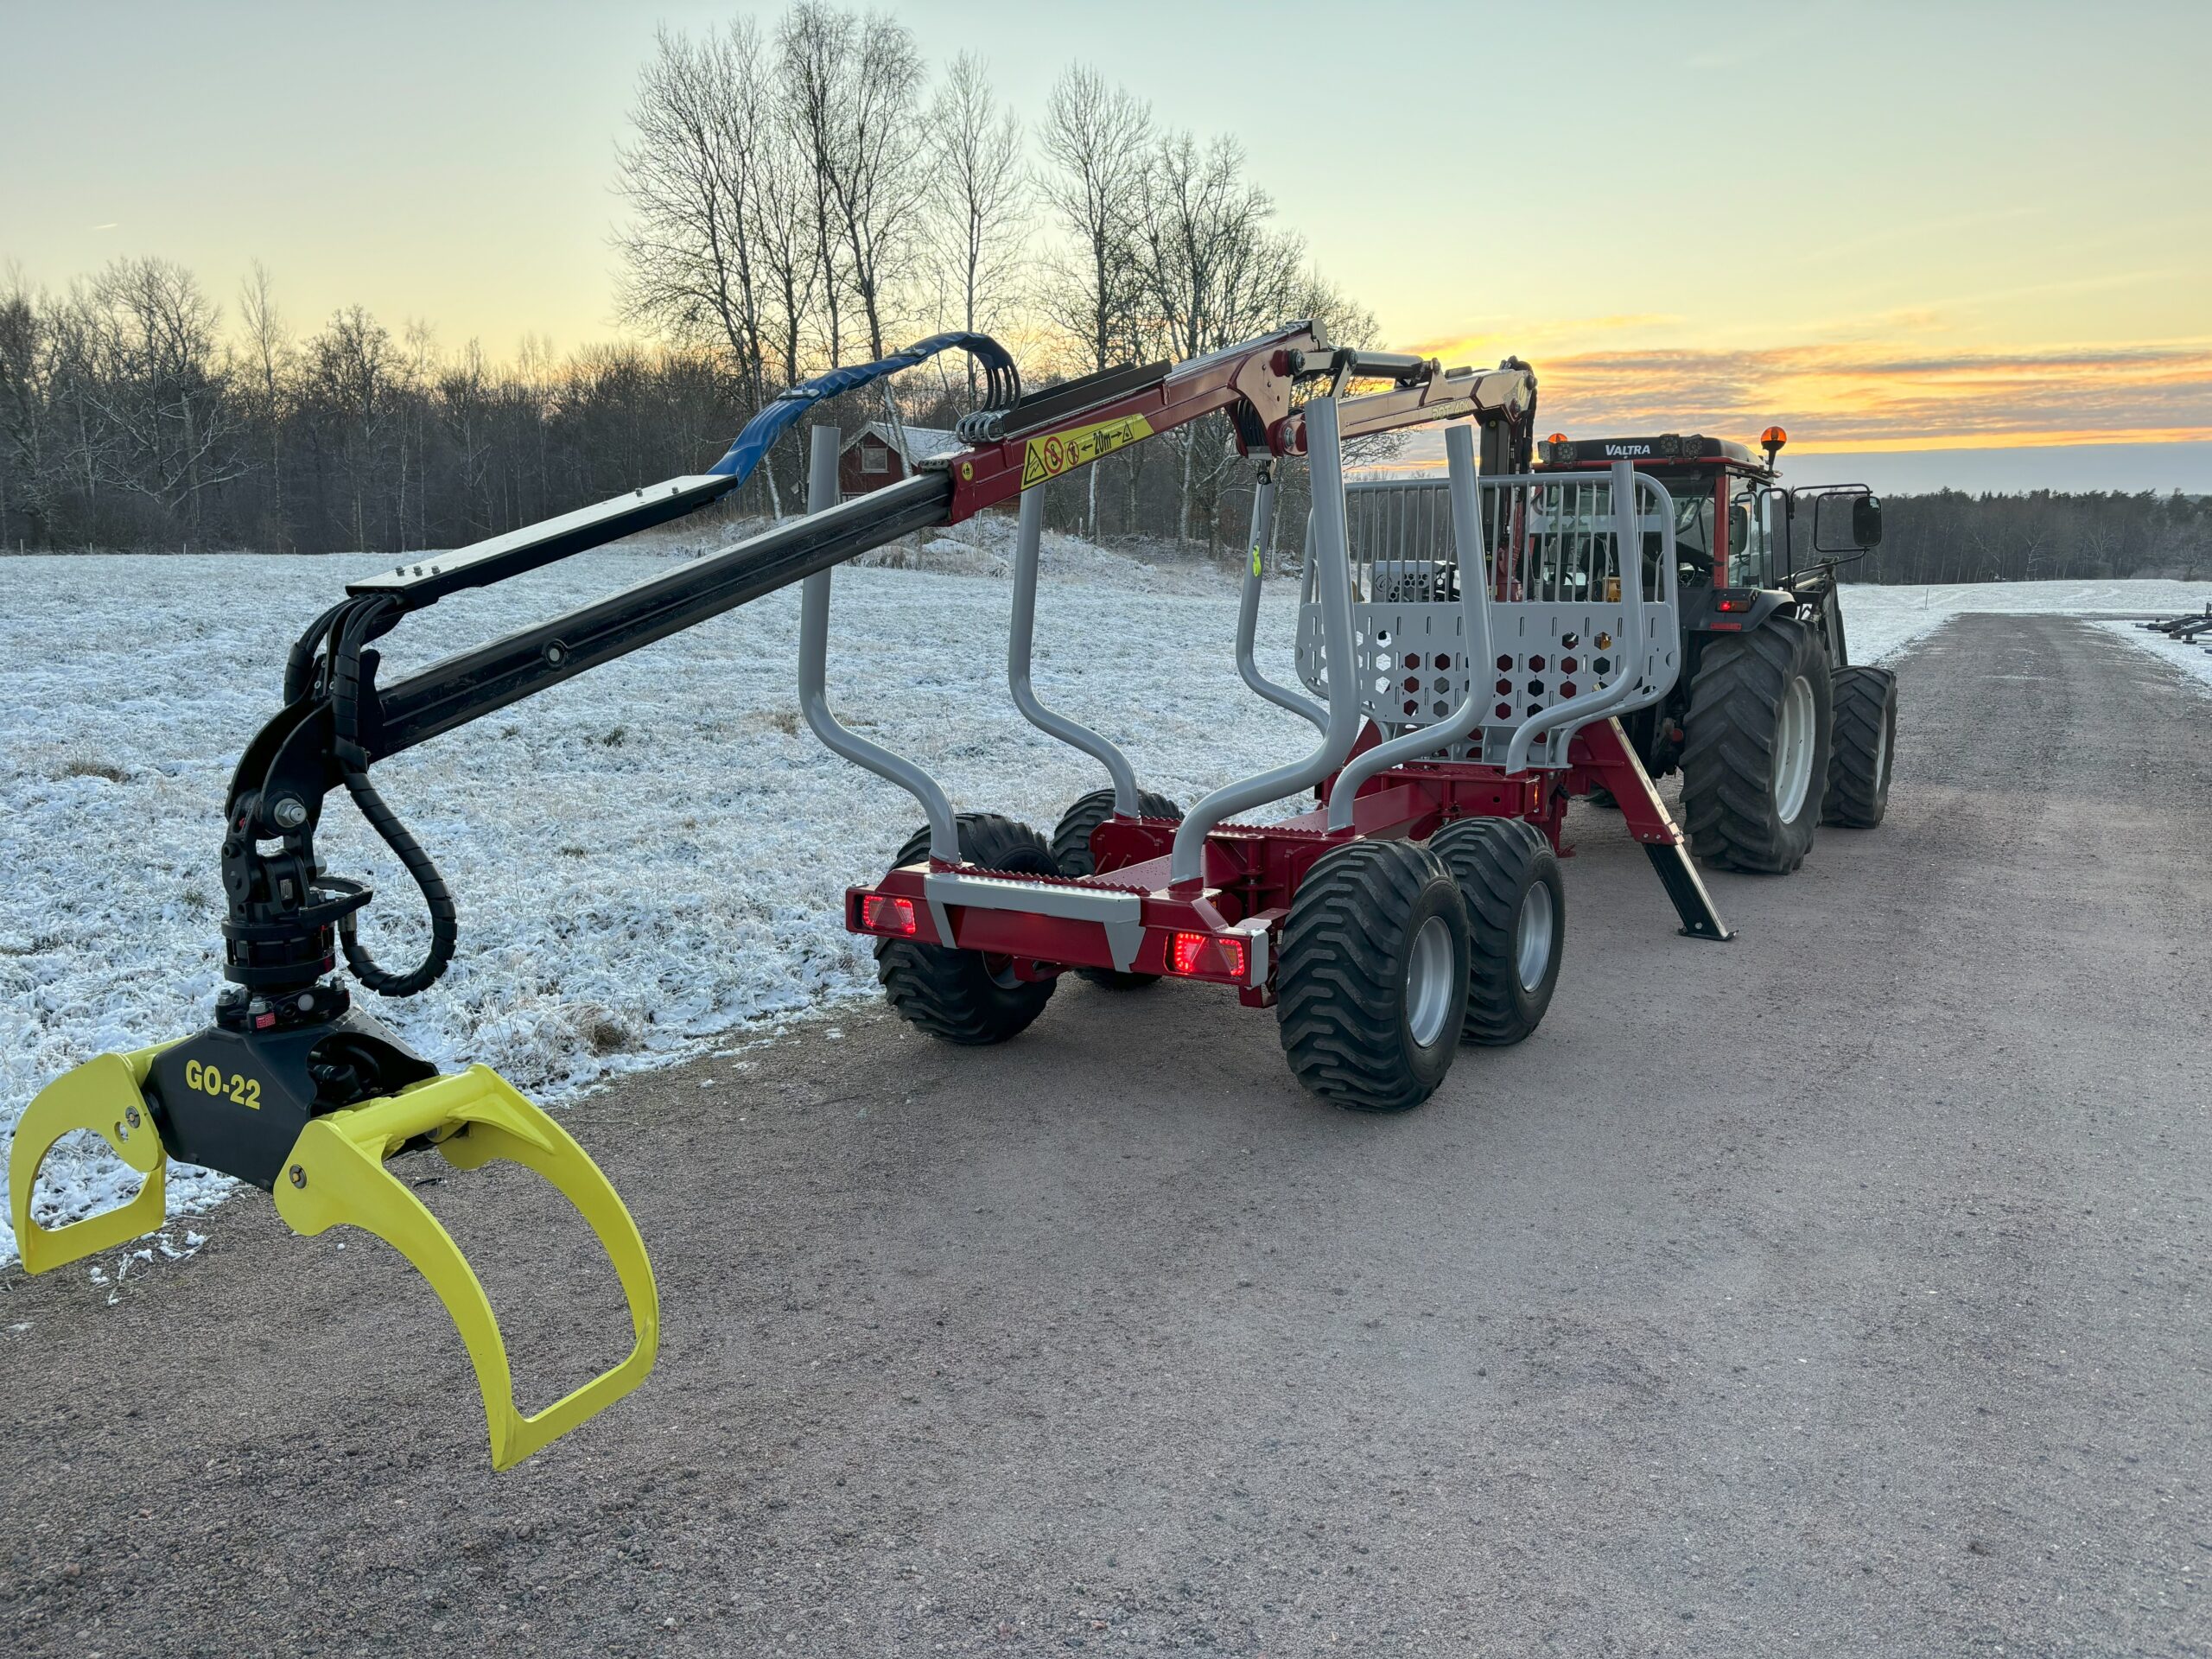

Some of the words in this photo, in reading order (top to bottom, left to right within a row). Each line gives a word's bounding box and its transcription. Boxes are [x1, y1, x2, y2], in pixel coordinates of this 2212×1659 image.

[1093, 430, 1112, 454] 20m
[1605, 444, 1651, 456] VALTRA
[185, 1059, 261, 1110] GO-22
